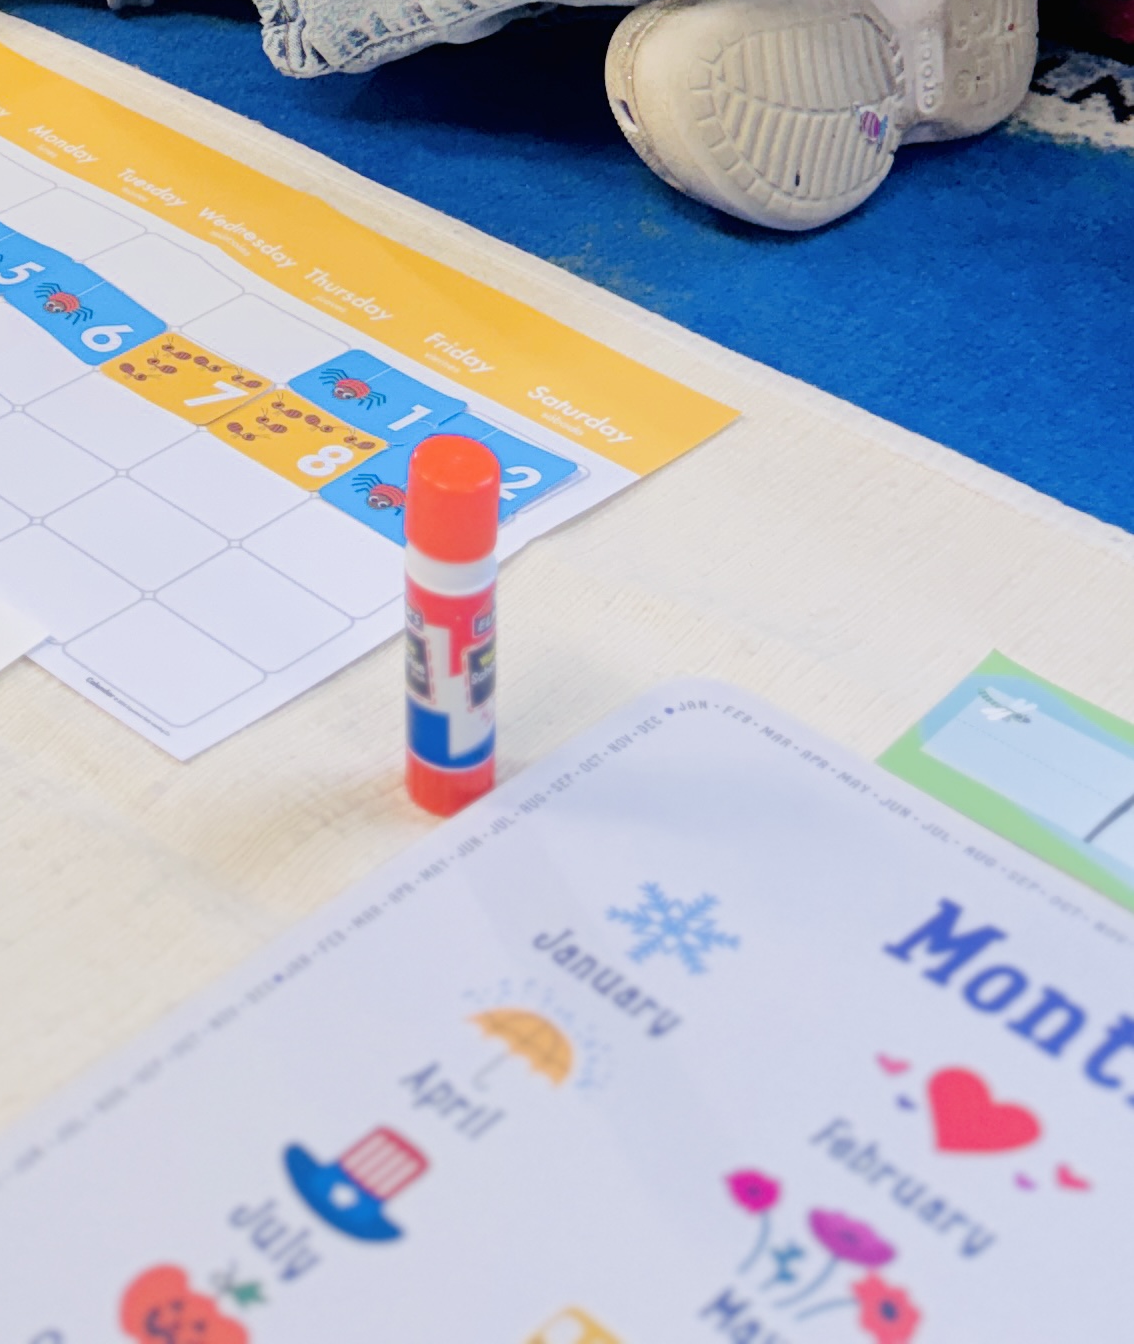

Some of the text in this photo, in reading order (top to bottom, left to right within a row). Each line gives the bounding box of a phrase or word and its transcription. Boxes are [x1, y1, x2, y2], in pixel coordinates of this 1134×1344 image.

[27, 124, 100, 164] Monday
[117, 166, 187, 207] Tuesday
[197, 206, 297, 269] Wednesday
[303, 267, 395, 323] Thursday
[79, 323, 136, 354] 6
[422, 331, 497, 374] Friday
[182, 380, 250, 409] 7
[386, 403, 434, 433] 1
[526, 384, 634, 444] Saturday
[296, 445, 355, 478] 8
[498, 464, 543, 502] 2
[678, 699, 709, 712] JAN
[722, 704, 753, 724] FEB
[759, 725, 792, 748] MAR
[835, 767, 872, 798] MAY
[533, 928, 683, 1040] January
[881, 897, 1134, 1108] Mont
[399, 1059, 506, 1142] April
[810, 1116, 997, 1260] February
[227, 1197, 323, 1283] July
